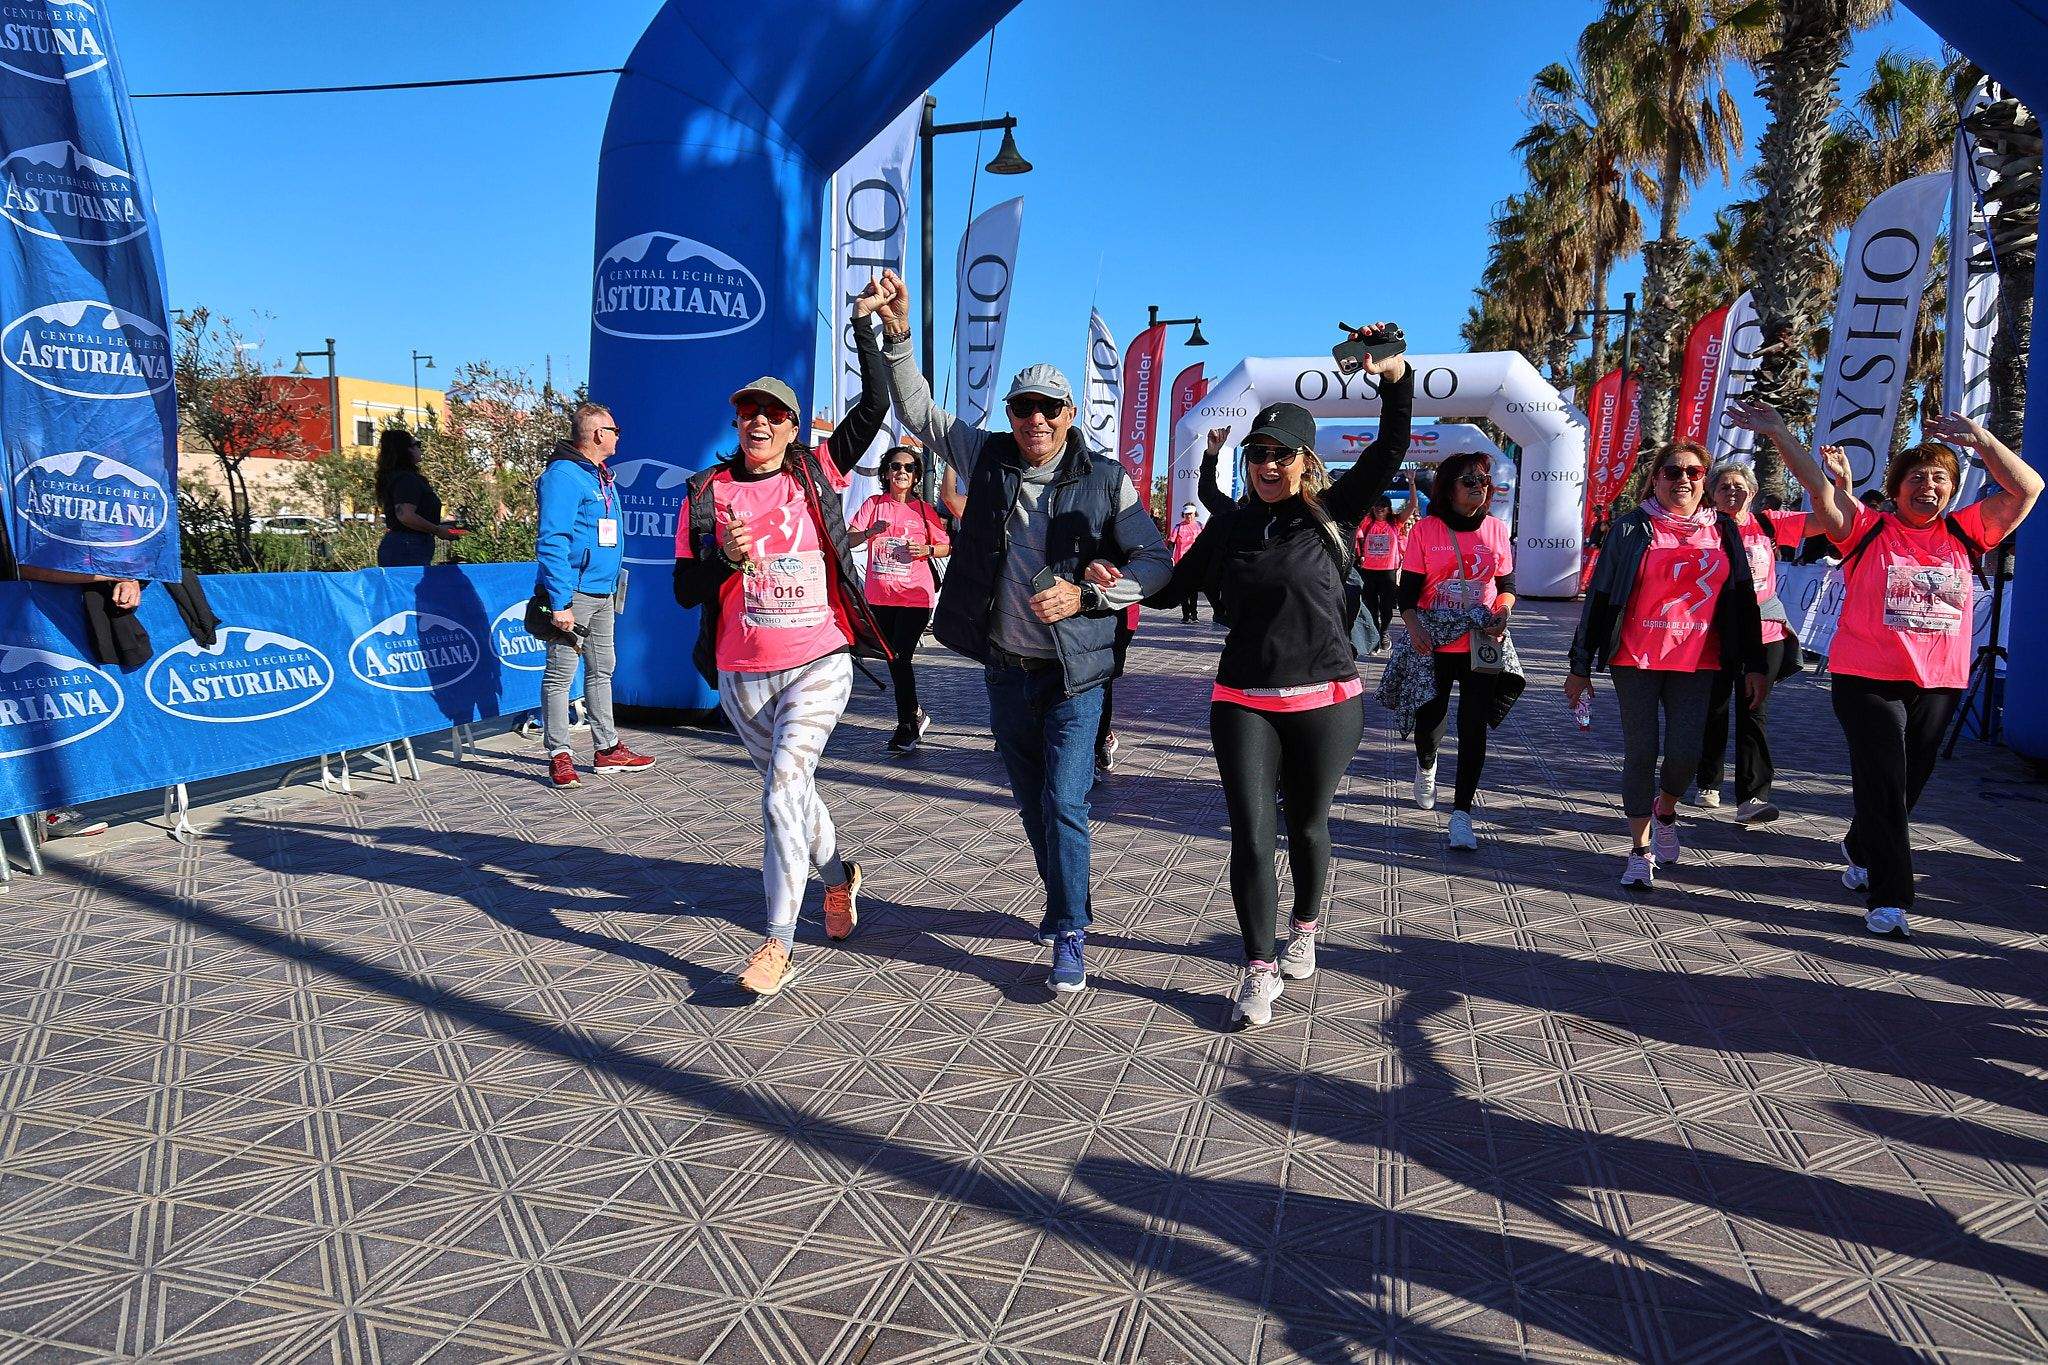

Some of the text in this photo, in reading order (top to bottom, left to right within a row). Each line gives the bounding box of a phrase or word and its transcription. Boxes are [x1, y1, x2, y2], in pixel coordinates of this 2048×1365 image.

[26, 172, 79, 186] CENTRA
[4, 172, 145, 222] ASTURIANA
[610, 269, 744, 287] CENTRAL LECHERA
[595, 275, 750, 319] ASTURIANA
[41, 330, 165, 350] CENTRAL LECHERA
[967, 254, 1009, 428] YSHO
[17, 330, 169, 379] ASTURIANA
[1131, 353, 1152, 440] Santander
[1687, 335, 1722, 438] Santander
[1201, 406, 1247, 417] OYSHO
[1506, 401, 1558, 414] OYSHO
[1597, 392, 1614, 464] Santander
[1178, 468, 1220, 480] OYS
[1531, 470, 1579, 482] OYSHO
[42, 479, 156, 500] CENTRAL LECHERA
[25, 479, 155, 529] ASTURIANA
[1527, 537, 1576, 549] OYSHO
[774, 586, 805, 598] 016
[499, 630, 546, 656] ASTUR
[189, 652, 311, 673] CENTRAL LECHERA
[367, 643, 474, 678] ASTURIANA
[13, 674, 93, 691] LECHERA
[166, 664, 325, 706] ASTURIANA
[0, 688, 111, 726] RIANA
